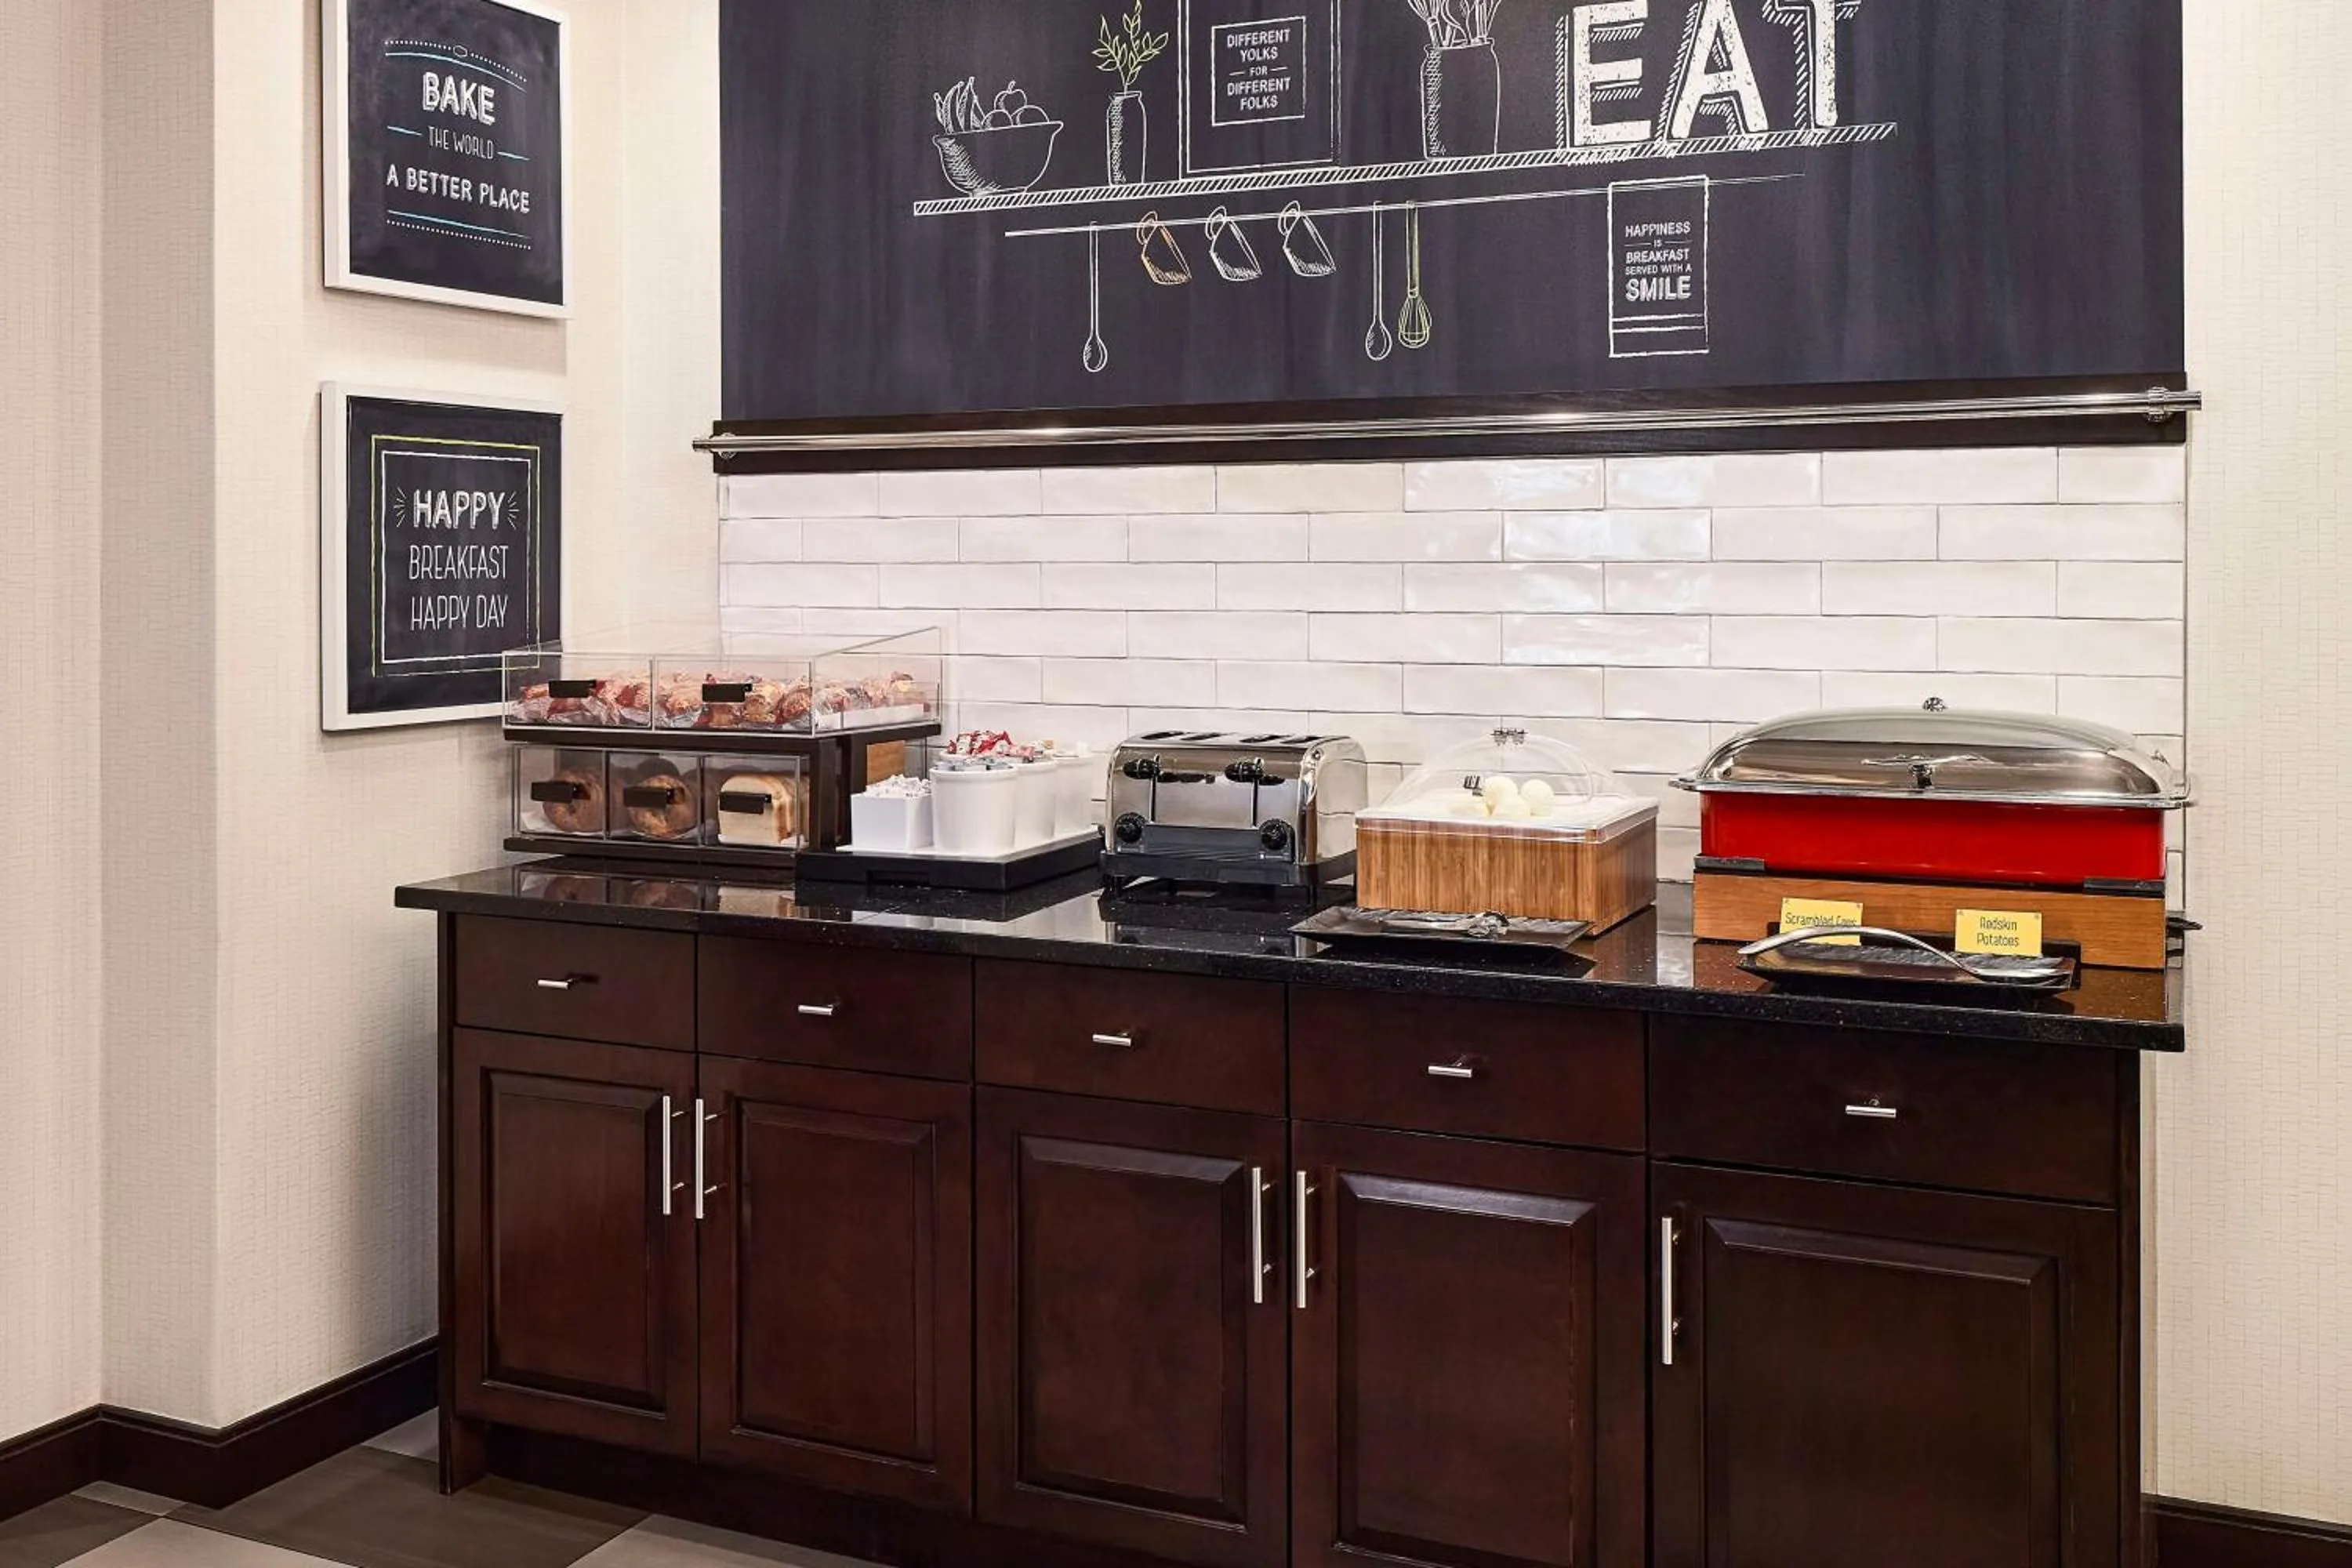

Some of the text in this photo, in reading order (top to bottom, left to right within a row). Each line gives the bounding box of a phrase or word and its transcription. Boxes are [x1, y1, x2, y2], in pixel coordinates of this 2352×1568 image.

[1227, 29, 1290, 48] DIFFERENT
[1240, 46, 1278, 63] YOLKS
[1250, 66, 1268, 77] FOR
[1556, 0, 1860, 147] EAT
[1227, 77, 1291, 96] DIFFERENT
[423, 71, 495, 125] BAKE
[1240, 95, 1278, 111] FOLKS
[429, 125, 494, 159] THE WORLD
[387, 164, 530, 214] A BETTER PLACE
[1625, 221, 1691, 238] HAPPINESS
[1653, 239, 1662, 248] IS
[1626, 249, 1690, 264] BREAKFAST
[1625, 263, 1692, 276] SERVED WITH A
[1625, 275, 1691, 302] SMILE
[413, 488, 506, 530] HAPPY
[408, 545, 509, 580] BREAKFAST
[410, 594, 508, 630] HAPPY DAY
[1980, 916, 2017, 931] Redskin
[1976, 932, 2020, 947] Potatoes
